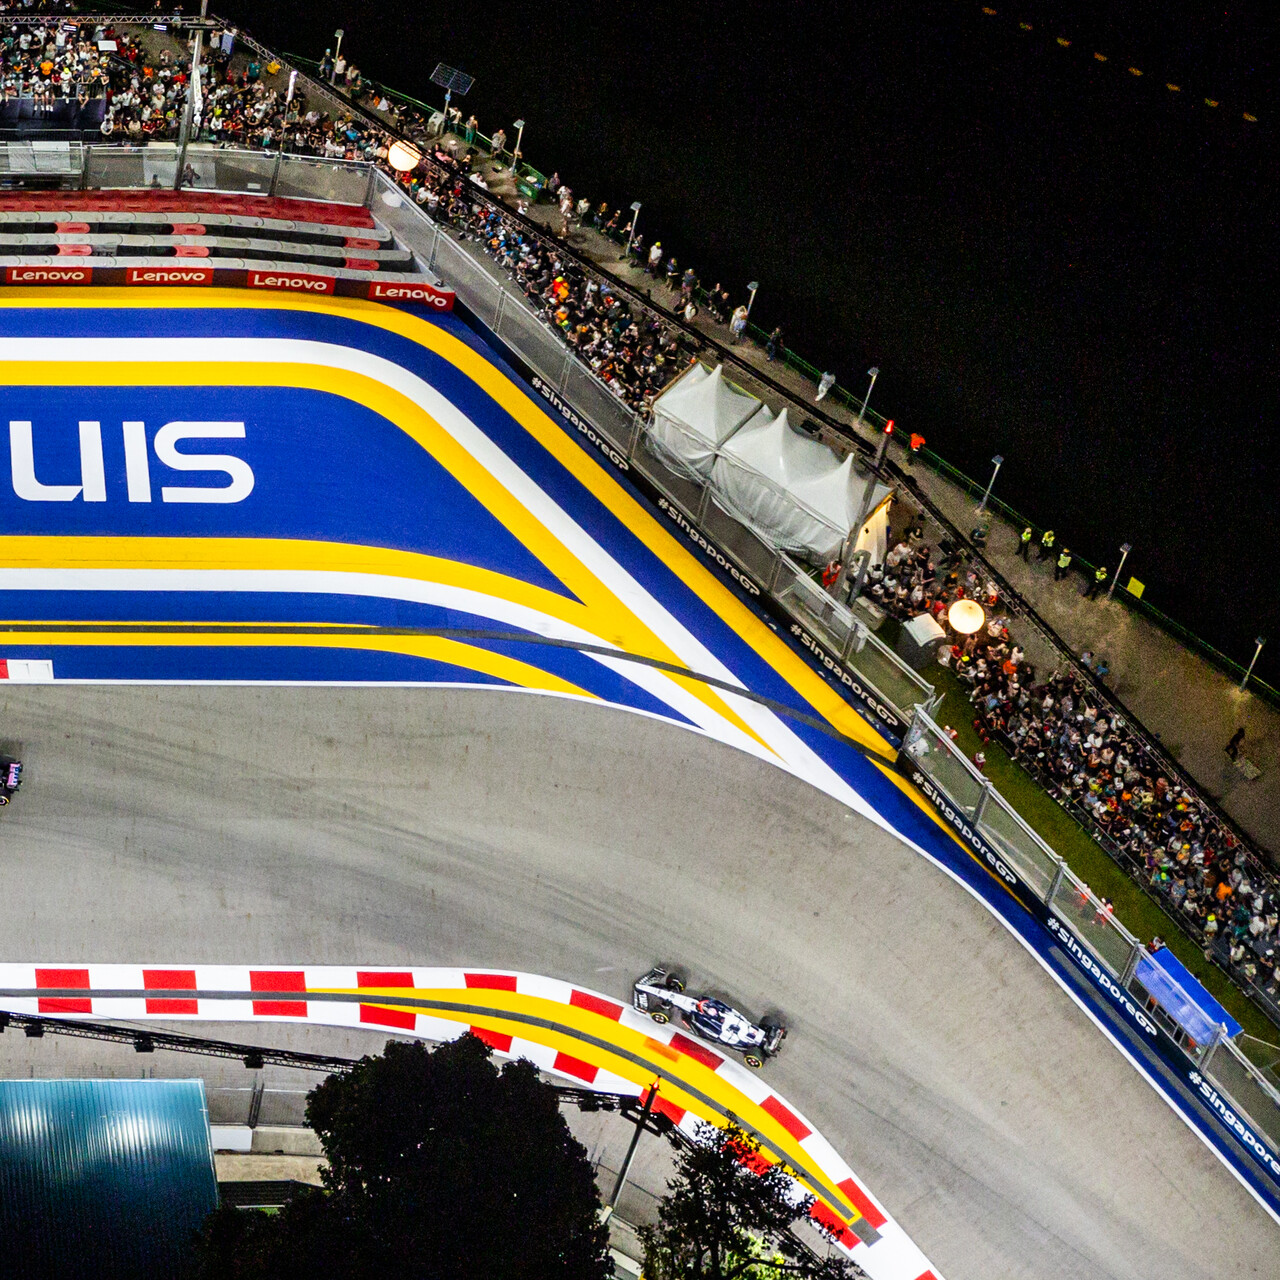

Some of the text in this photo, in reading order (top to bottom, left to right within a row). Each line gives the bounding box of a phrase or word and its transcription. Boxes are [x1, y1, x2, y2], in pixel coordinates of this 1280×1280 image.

[12, 270, 85, 280] Lenovo
[132, 271, 205, 282] Lenovo
[254, 274, 327, 291] Lenovo
[375, 285, 447, 307] Lenovo
[531, 377, 630, 471] #SingaporeGP
[657, 498, 760, 596] #SingaporeGP
[790, 623, 898, 726] #SingaporeGP
[912, 772, 1017, 884] #SingaporeGP
[1047, 917, 1157, 1036] #SingaporeGP
